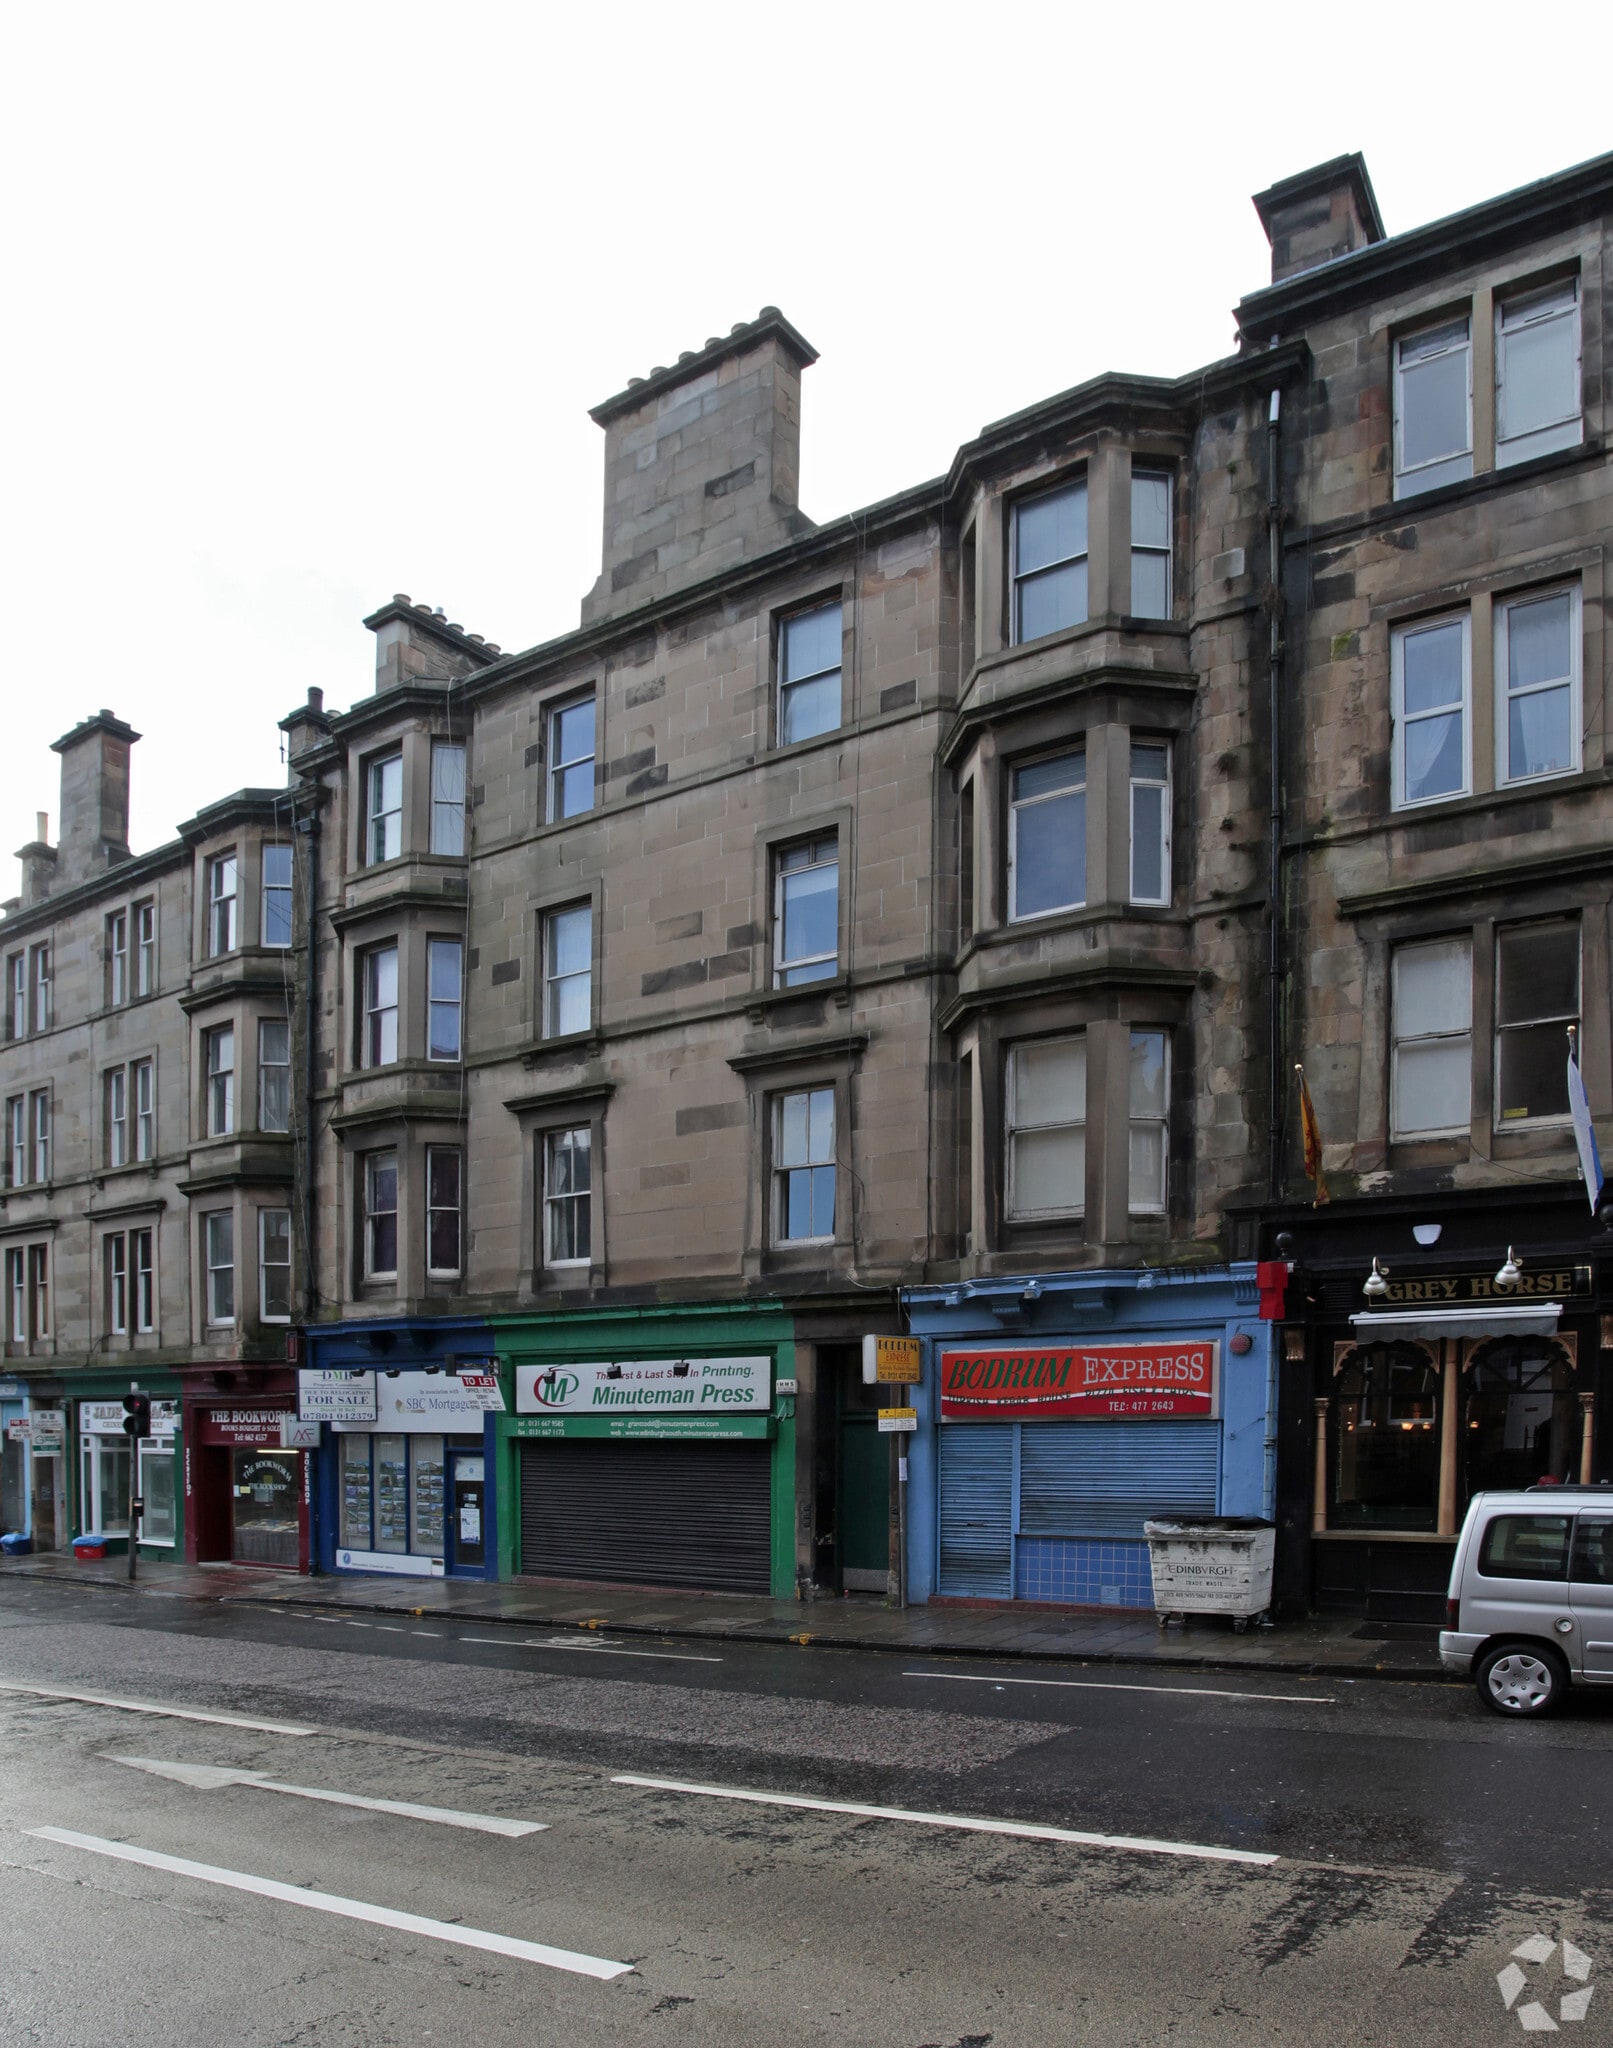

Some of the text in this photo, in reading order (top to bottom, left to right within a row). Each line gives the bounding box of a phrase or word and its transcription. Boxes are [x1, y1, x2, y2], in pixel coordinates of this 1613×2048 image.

[1385, 1279, 1459, 1301] GREY
[322, 1370, 354, 1380] DMB
[636, 1370, 642, 1379] &
[644, 1369, 664, 1379] Last
[690, 1369, 699, 1378] In
[947, 1352, 1205, 1390] BODRUM EXPRESS
[463, 1377, 494, 1386] TO LET
[592, 1383, 755, 1405] Minuteman Press
[307, 1395, 369, 1405] FOR SALE
[406, 1397, 425, 1410] SBC
[1109, 1400, 1175, 1412] TEL: 477 2643
[210, 1410, 293, 1423] THE BOOKWOR
[220, 1424, 239, 1432] BOOKS
[239, 1424, 261, 1432] BOUGHT
[541, 1420, 551, 1428] 667
[541, 1428, 552, 1436] 667
